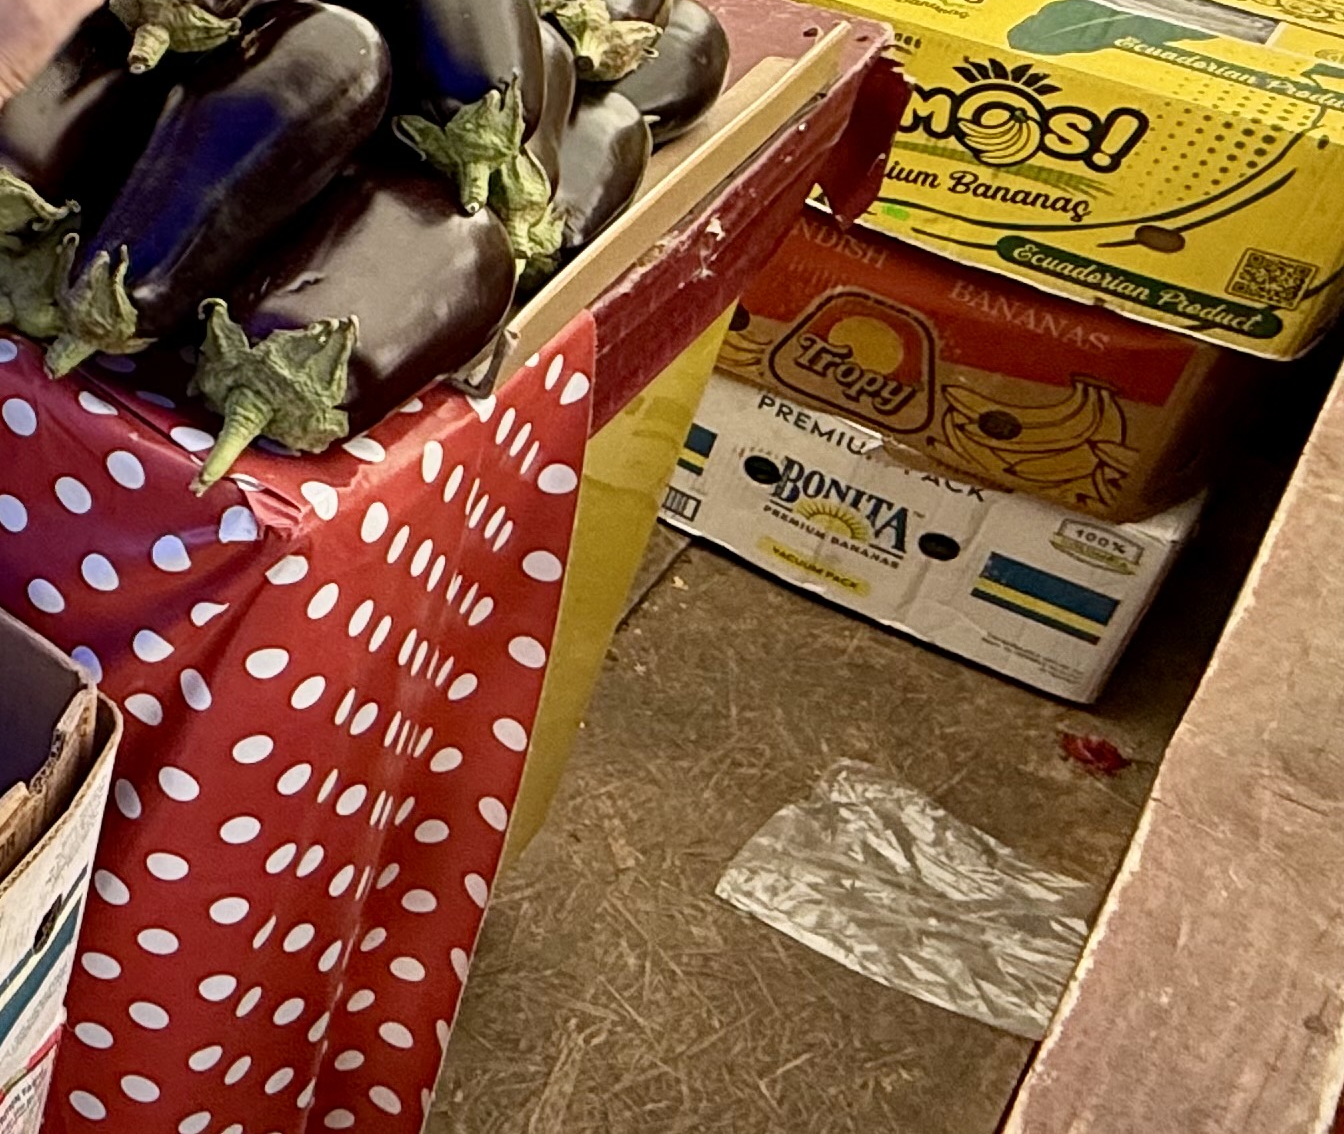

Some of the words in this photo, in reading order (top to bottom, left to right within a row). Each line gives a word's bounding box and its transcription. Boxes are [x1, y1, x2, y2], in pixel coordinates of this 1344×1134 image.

[1114, 36, 1257, 86] Ecuadorian
[1265, 77, 1344, 110] Produ
[898, 82, 1150, 174] MOS!
[948, 170, 1093, 223] Bananas
[787, 218, 891, 269] NDISH
[948, 278, 1111, 353] BANANAS
[1011, 243, 1151, 303] Ecuadorian
[1155, 289, 1266, 334] Product
[794, 330, 917, 414] Tropy
[758, 394, 874, 461] PREMIU
[904, 467, 986, 503] ACK
[763, 503, 827, 542] PREMIUM
[831, 535, 900, 570] BANANAS
[771, 455, 910, 554] BONITA
[1075, 528, 1127, 554] 100%
